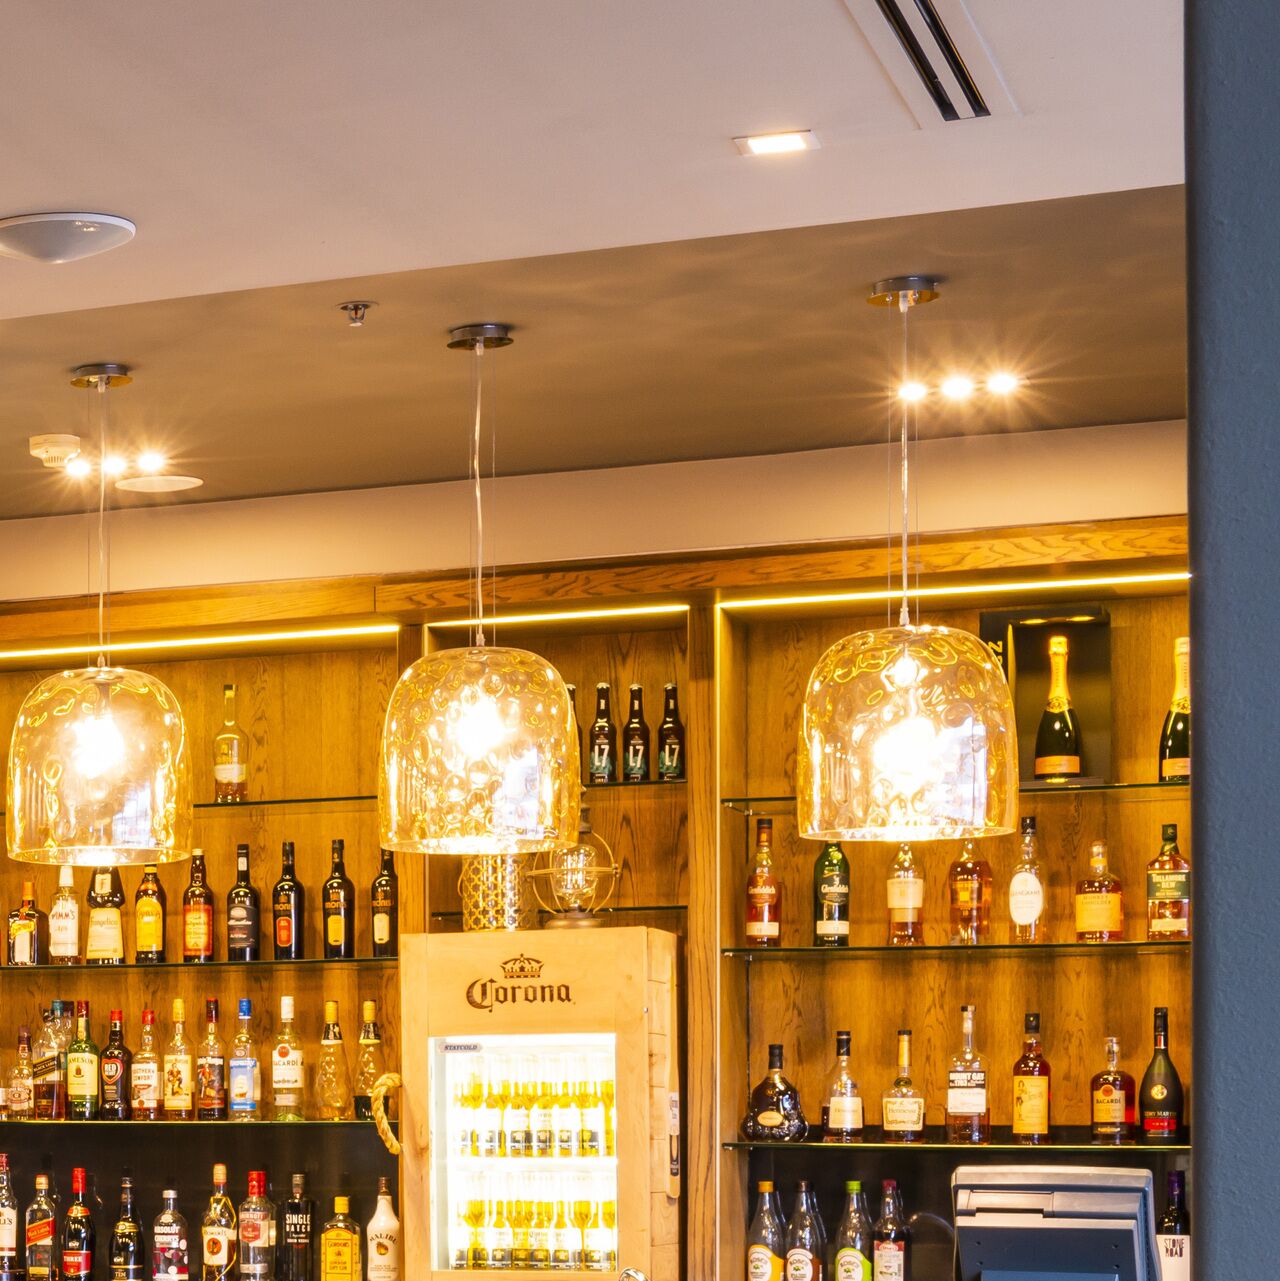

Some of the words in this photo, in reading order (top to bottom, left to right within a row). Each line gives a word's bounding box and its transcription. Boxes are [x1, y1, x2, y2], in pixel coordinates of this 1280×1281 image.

[466, 978, 572, 1013] Corona
[286, 1214, 311, 1224] SINGLE
[1164, 1238, 1184, 1249] STONE
